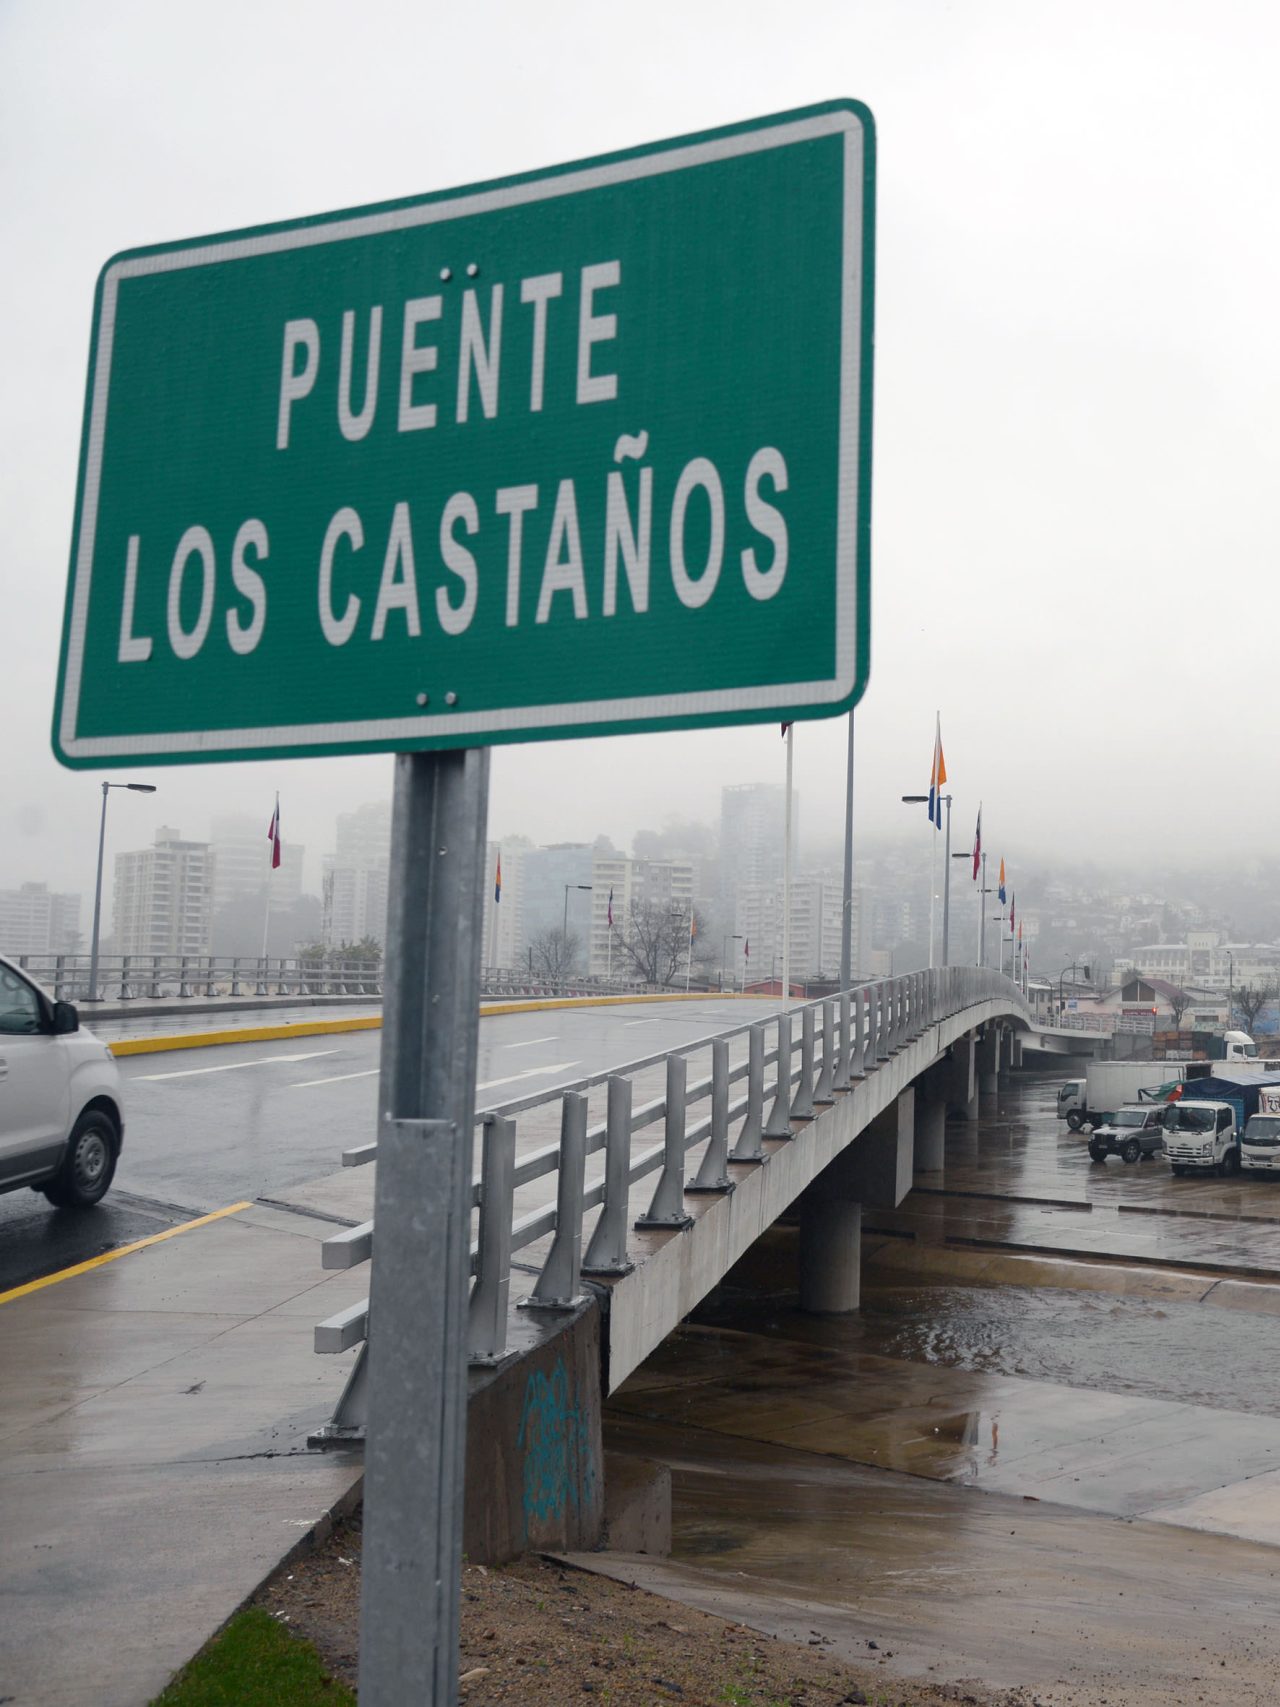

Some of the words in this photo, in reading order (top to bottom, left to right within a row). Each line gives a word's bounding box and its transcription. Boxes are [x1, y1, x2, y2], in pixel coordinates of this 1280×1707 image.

[276, 260, 621, 449] PUENTE
[118, 519, 269, 662] LOS
[319, 431, 789, 646] CASTAÑOS
